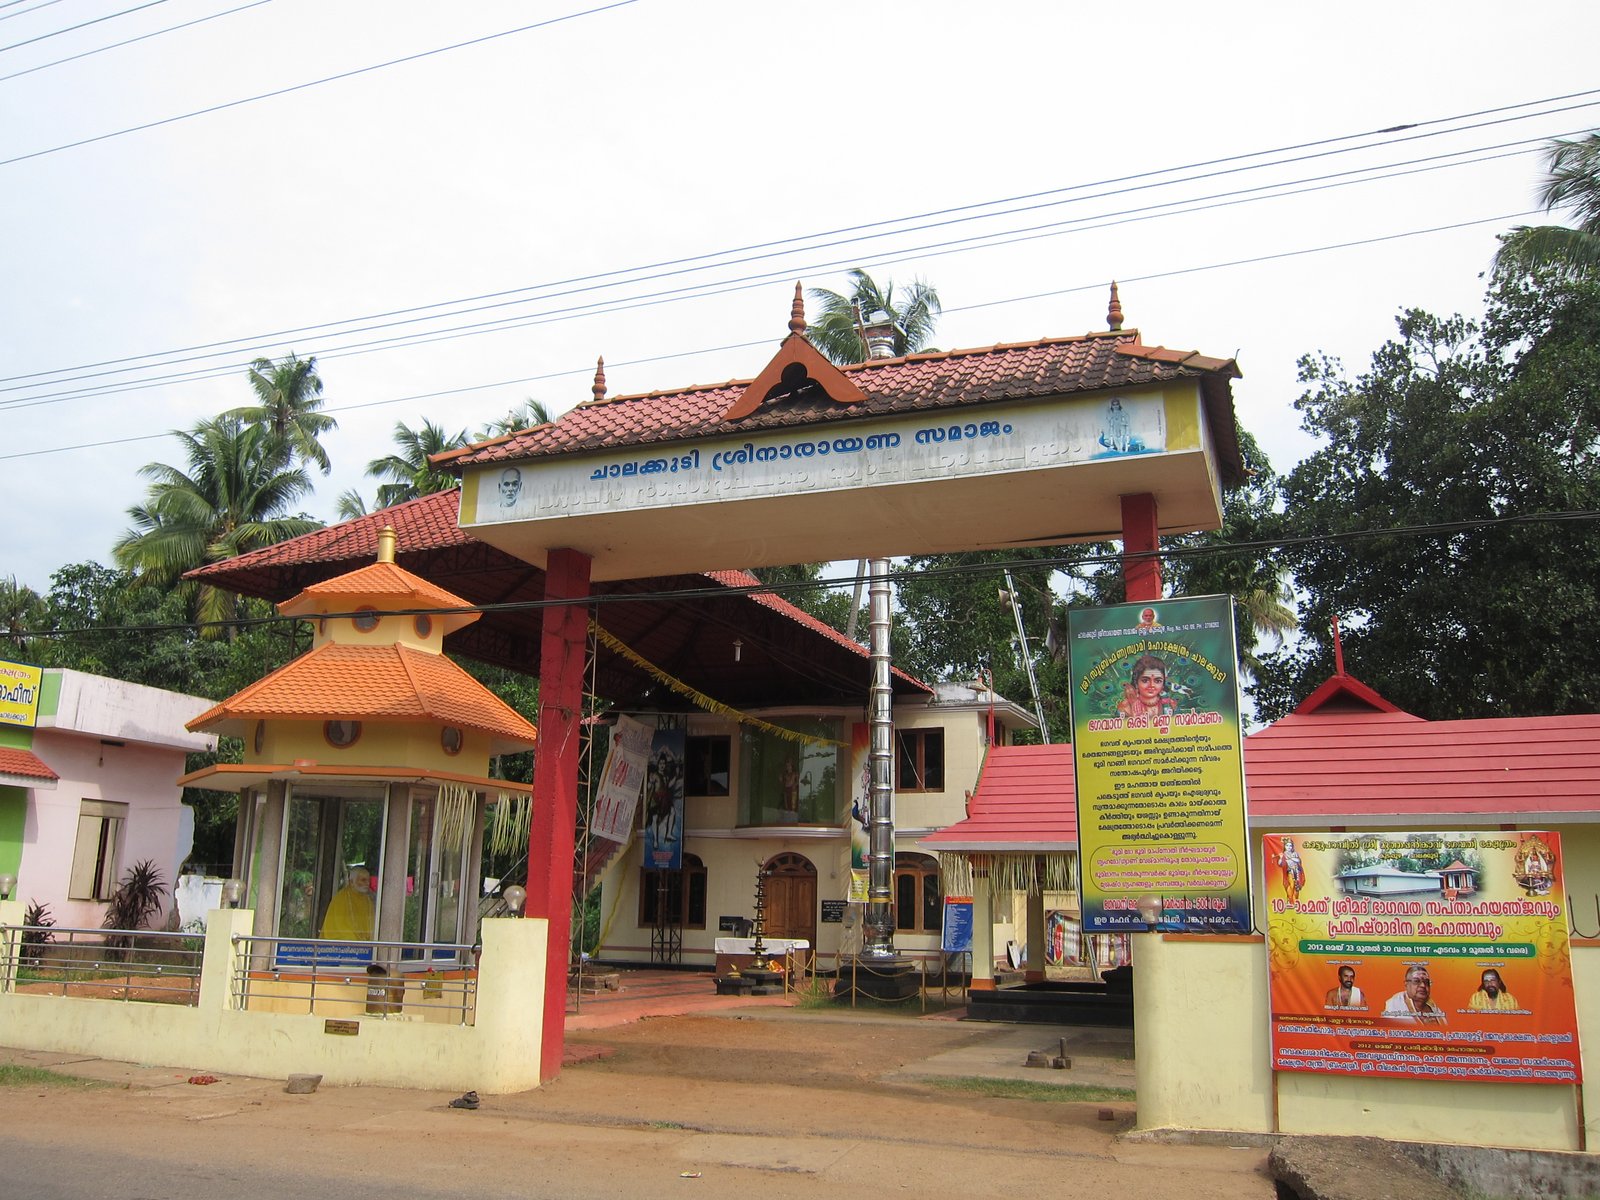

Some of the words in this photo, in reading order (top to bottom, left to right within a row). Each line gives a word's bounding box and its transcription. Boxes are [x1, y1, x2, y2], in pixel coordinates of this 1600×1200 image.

[590, 449, 700, 481] ചാലക്കുടി
[712, 431, 901, 471] ശ്രീനാരായണ
[915, 420, 1013, 445] സമാജം
[1191, 653, 1227, 684] ചാലക്കുടി
[1088, 712, 1125, 732] ഭഗവാന്
[1127, 712, 1149, 729] ഒരടി
[1174, 708, 1223, 726] സമർപ്പണം
[1114, 783, 1125, 791] ഈ
[1362, 837, 1378, 850] ശ്രീ
[1444, 837, 1477, 850] ഭഗവതി
[1479, 840, 1518, 851] ക്ഷേത്രം
[1332, 895, 1370, 918] ശ്രീമദ്
[1372, 899, 1422, 916] ഭാഗവത
[1094, 916, 1107, 925] ഈ
[1417, 921, 1503, 940] മഹോത്സവും
[1325, 943, 1344, 951] മെയ്
[1356, 944, 1380, 953] മുതൽ
[1433, 946, 1460, 954] എടവം
[1468, 945, 1494, 955] മുതൽ
